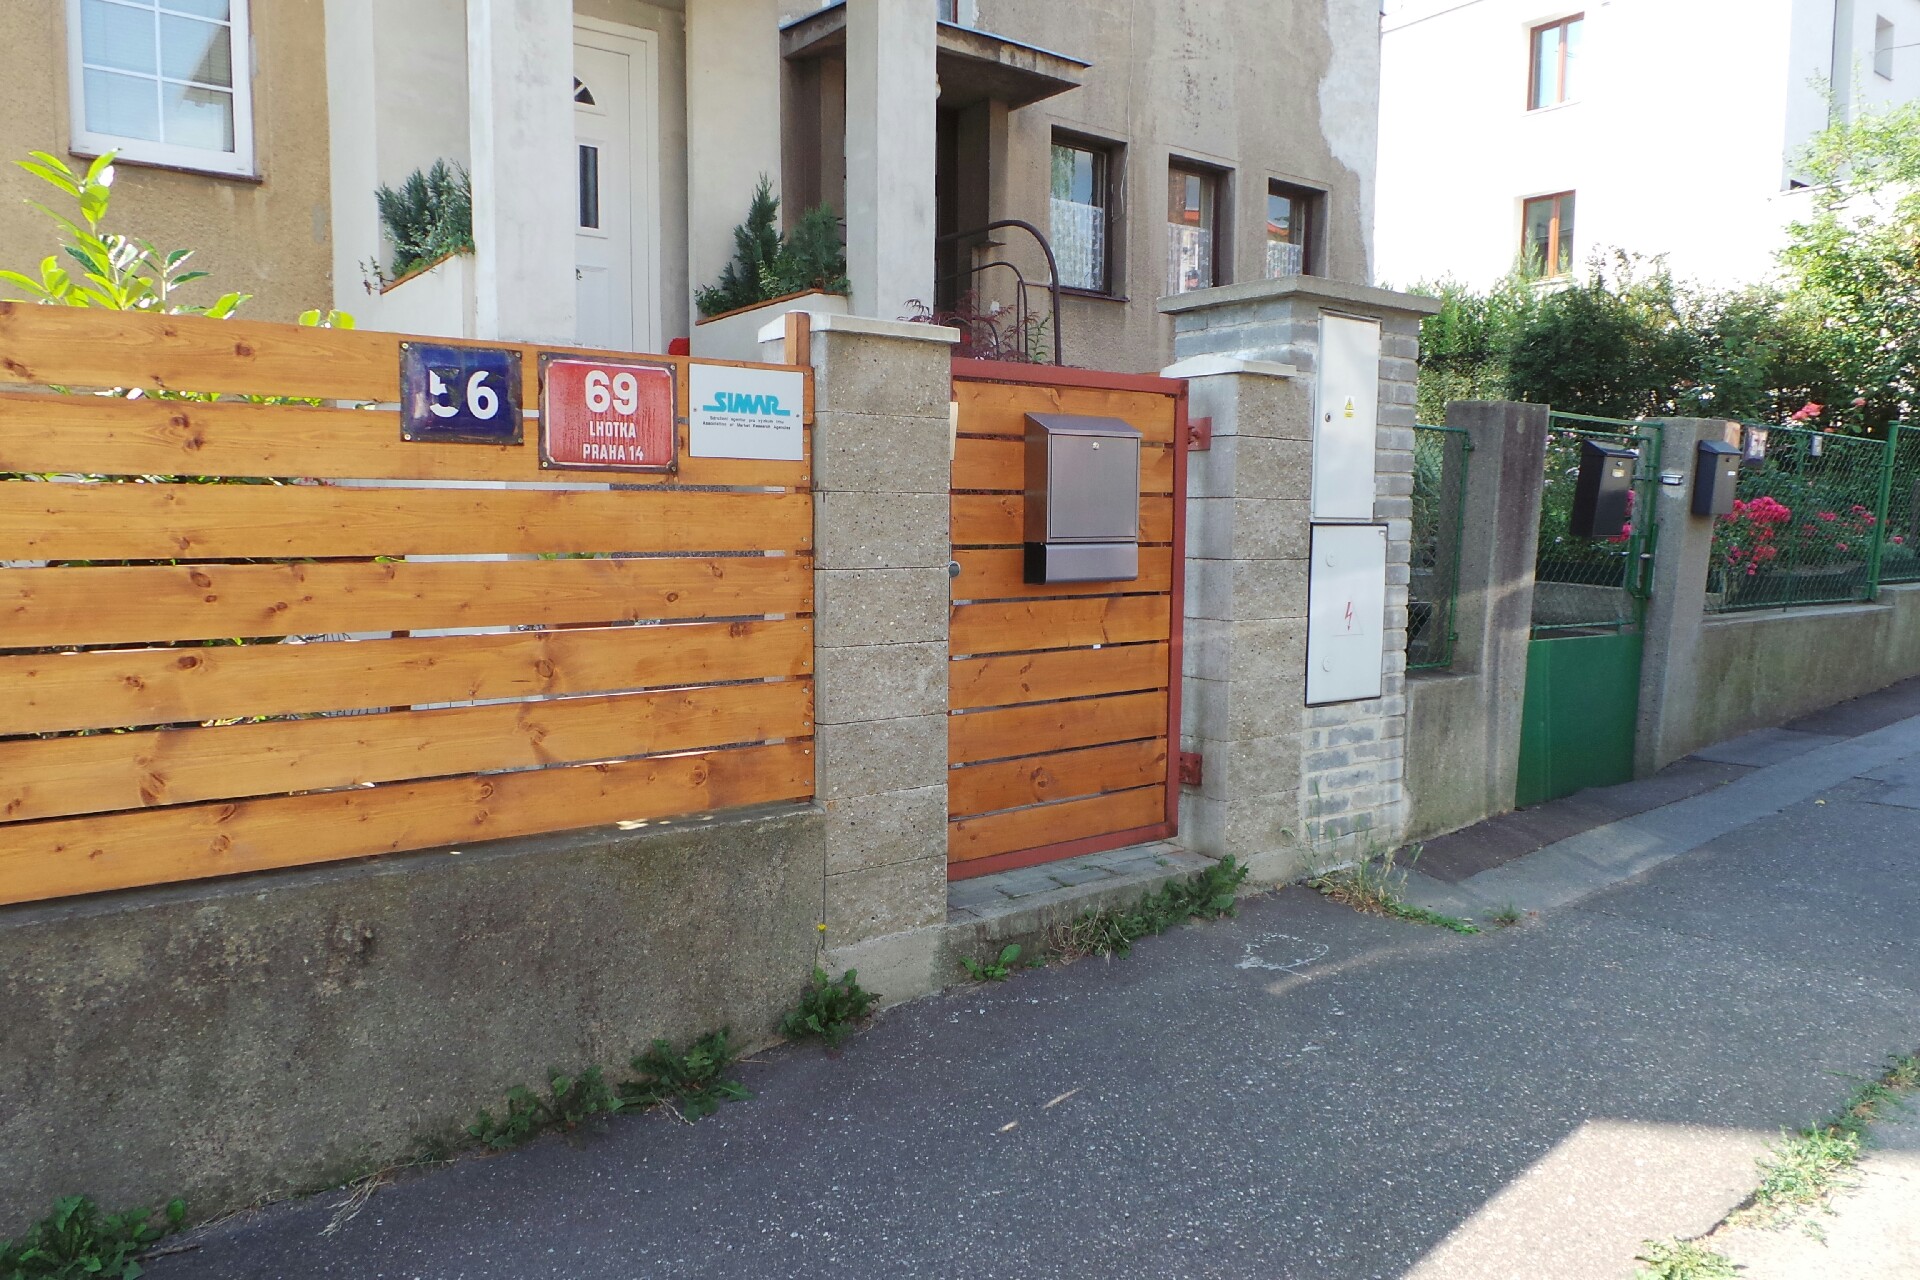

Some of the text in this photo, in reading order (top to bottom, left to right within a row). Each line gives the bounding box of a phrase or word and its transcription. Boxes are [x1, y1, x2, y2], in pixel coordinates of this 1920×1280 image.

[585, 370, 638, 415] 69
[703, 391, 791, 417] SIMAR
[589, 420, 637, 438] LHOTKA
[582, 443, 645, 461] PRAHA 14
